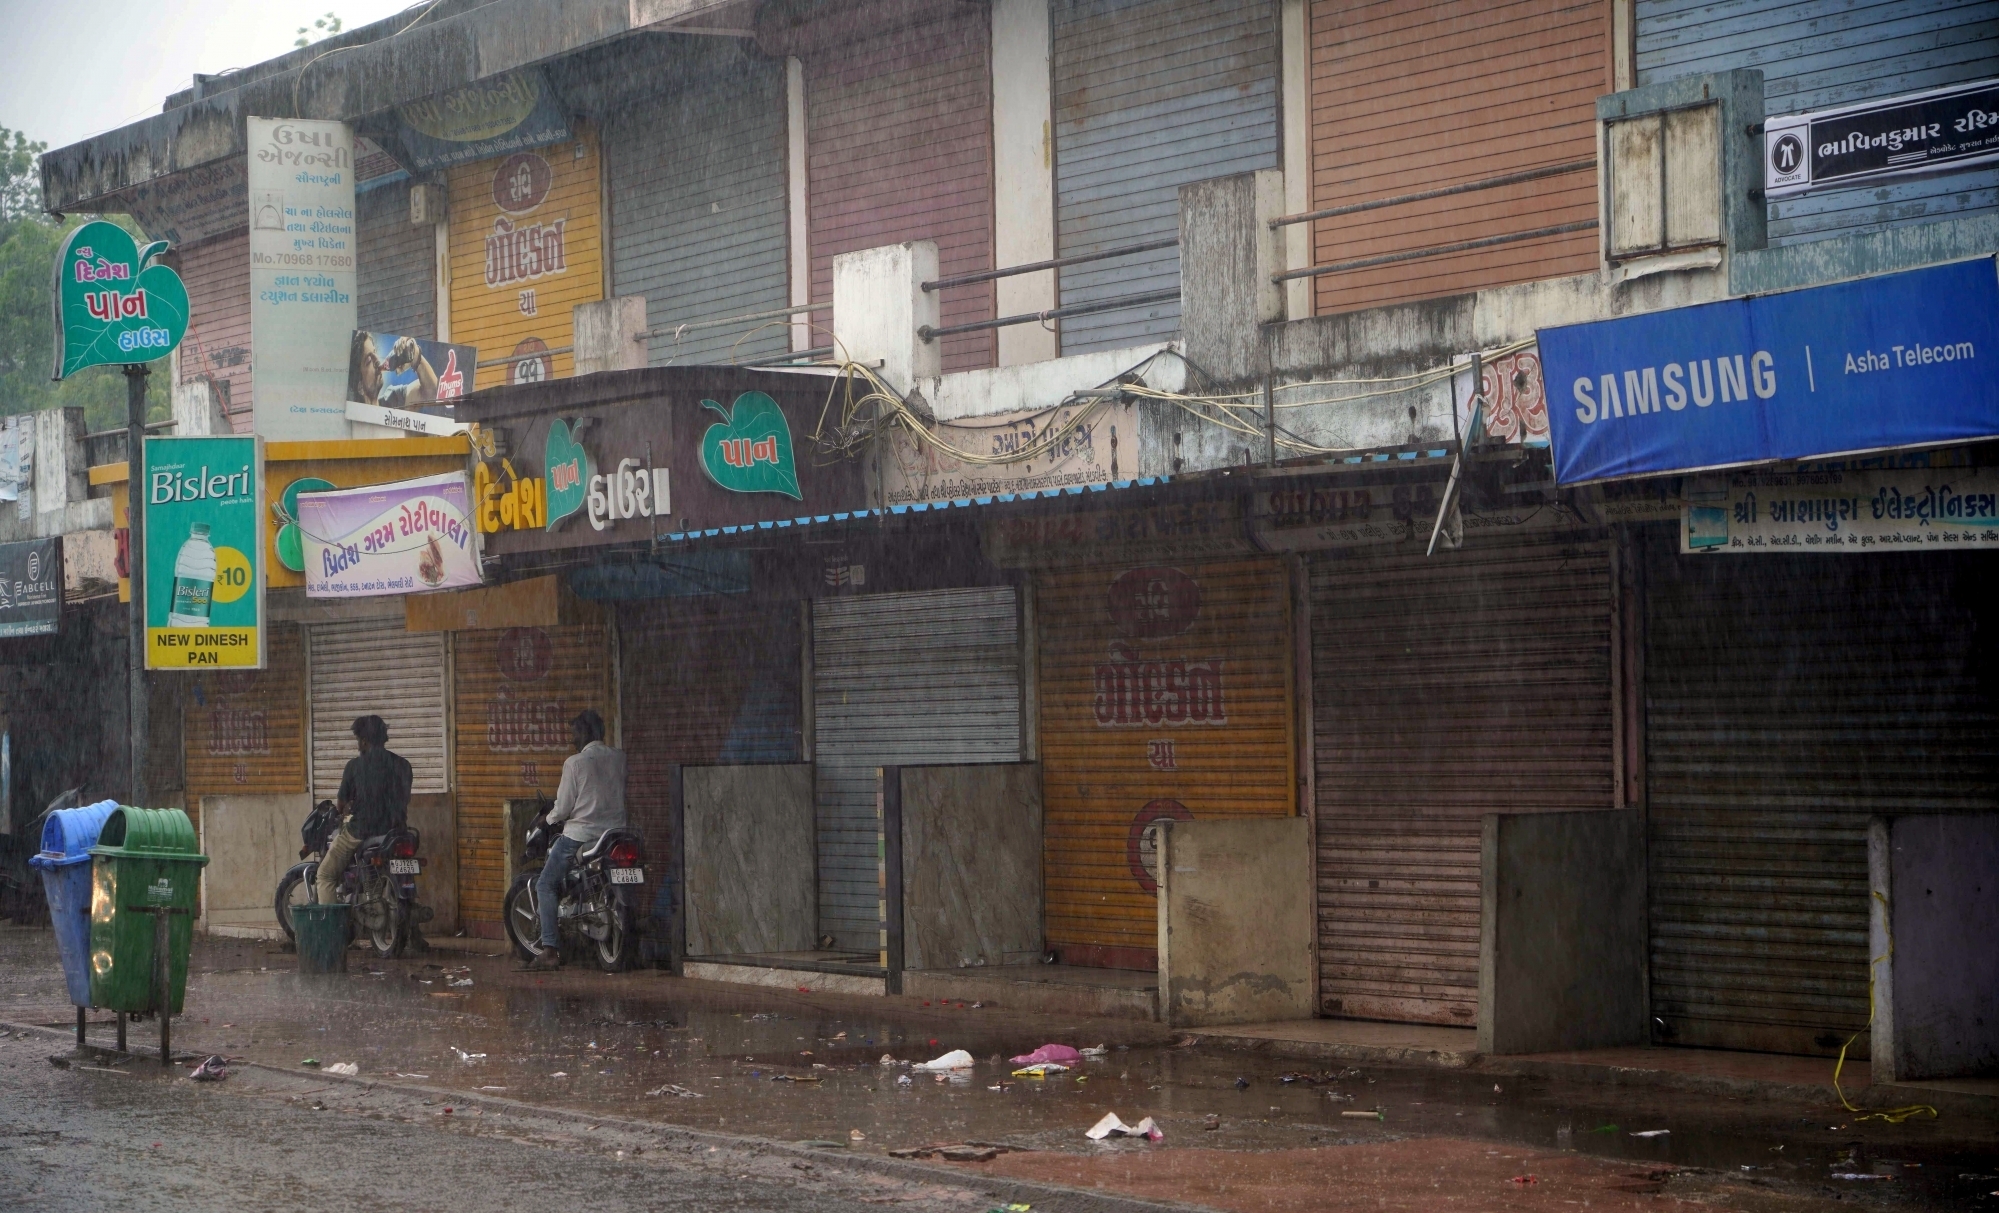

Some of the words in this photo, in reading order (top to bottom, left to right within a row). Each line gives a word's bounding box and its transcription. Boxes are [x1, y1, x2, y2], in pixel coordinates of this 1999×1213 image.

[272, 124, 333, 147] ઉષા
[1818, 123, 1941, 158] ભાવિનકુમાર
[1930, 144, 1957, 154] એડવોકેટ
[1959, 139, 1982, 151] ગુજરાત
[257, 143, 350, 169] એજન્સી
[295, 171, 341, 187] સૌરાષ્ટ્રની
[510, 162, 532, 202] રવિ
[1775, 174, 1801, 183] ADVOCATE
[285, 207, 298, 216] ચા
[301, 208, 312, 217] ના
[316, 205, 353, 219] હોલસેલ
[287, 223, 306, 232] તથા
[294, 238, 315, 251] મુખ્ય
[75, 259, 131, 282] દિનેશ
[316, 255, 352, 267] 17680
[274, 275, 300, 287] જ્ઞાન
[85, 288, 149, 322] પાન
[118, 325, 170, 352] હાઉસ
[1844, 352, 1890, 375] Asha
[1892, 340, 1975, 369] Telecom
[439, 379, 462, 394] Thums
[1573, 350, 1777, 425] SAMSUNG
[384, 410, 411, 429] સોમનાથ
[413, 421, 427, 432] પાન
[719, 435, 780, 468] પાન
[151, 463, 186, 473] Samajhdaar
[151, 464, 250, 506] Bisleri
[475, 458, 546, 533] દિનેશ
[551, 458, 581, 492] પાન
[220, 498, 239, 507] peete
[239, 496, 254, 504] hain.
[1734, 491, 1757, 523] શ્રી
[1769, 498, 1858, 531] આશાપુરા
[322, 542, 361, 579] પ્રિતેશ
[364, 521, 396, 554] ગરમ
[398, 500, 469, 551] રોટીવાલા
[177, 585, 210, 598] Bisleri
[157, 634, 191, 647] NEW
[194, 633, 248, 646] DINESH
[188, 651, 218, 664] PAN
